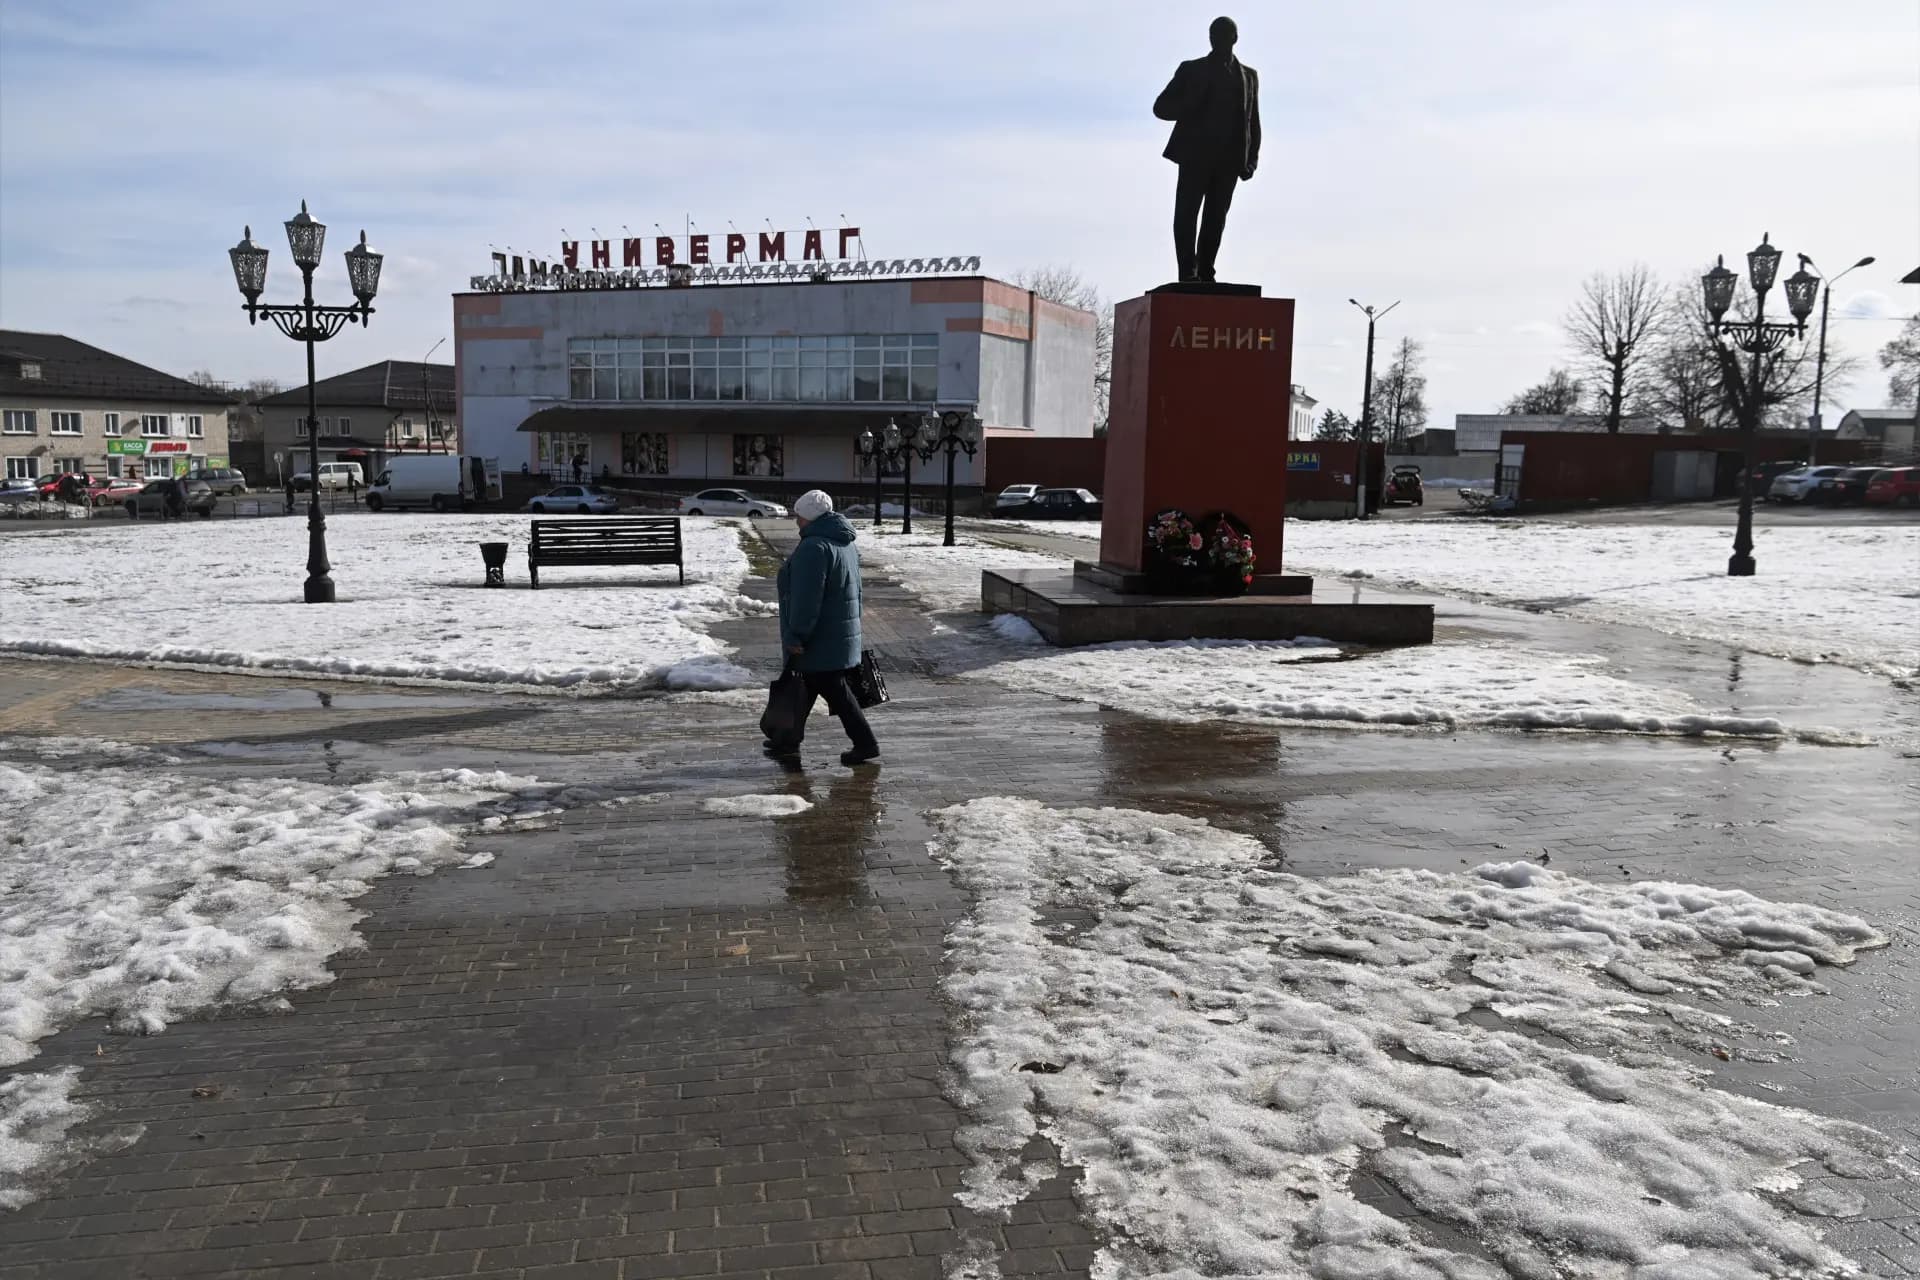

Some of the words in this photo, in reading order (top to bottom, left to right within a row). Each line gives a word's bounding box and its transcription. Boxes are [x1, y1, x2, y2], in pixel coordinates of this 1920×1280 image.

[562, 228, 860, 268] УНИВЕРМАГ
[1170, 326, 1275, 350] ЛЕНИН
[123, 441, 144, 449] КАССА
